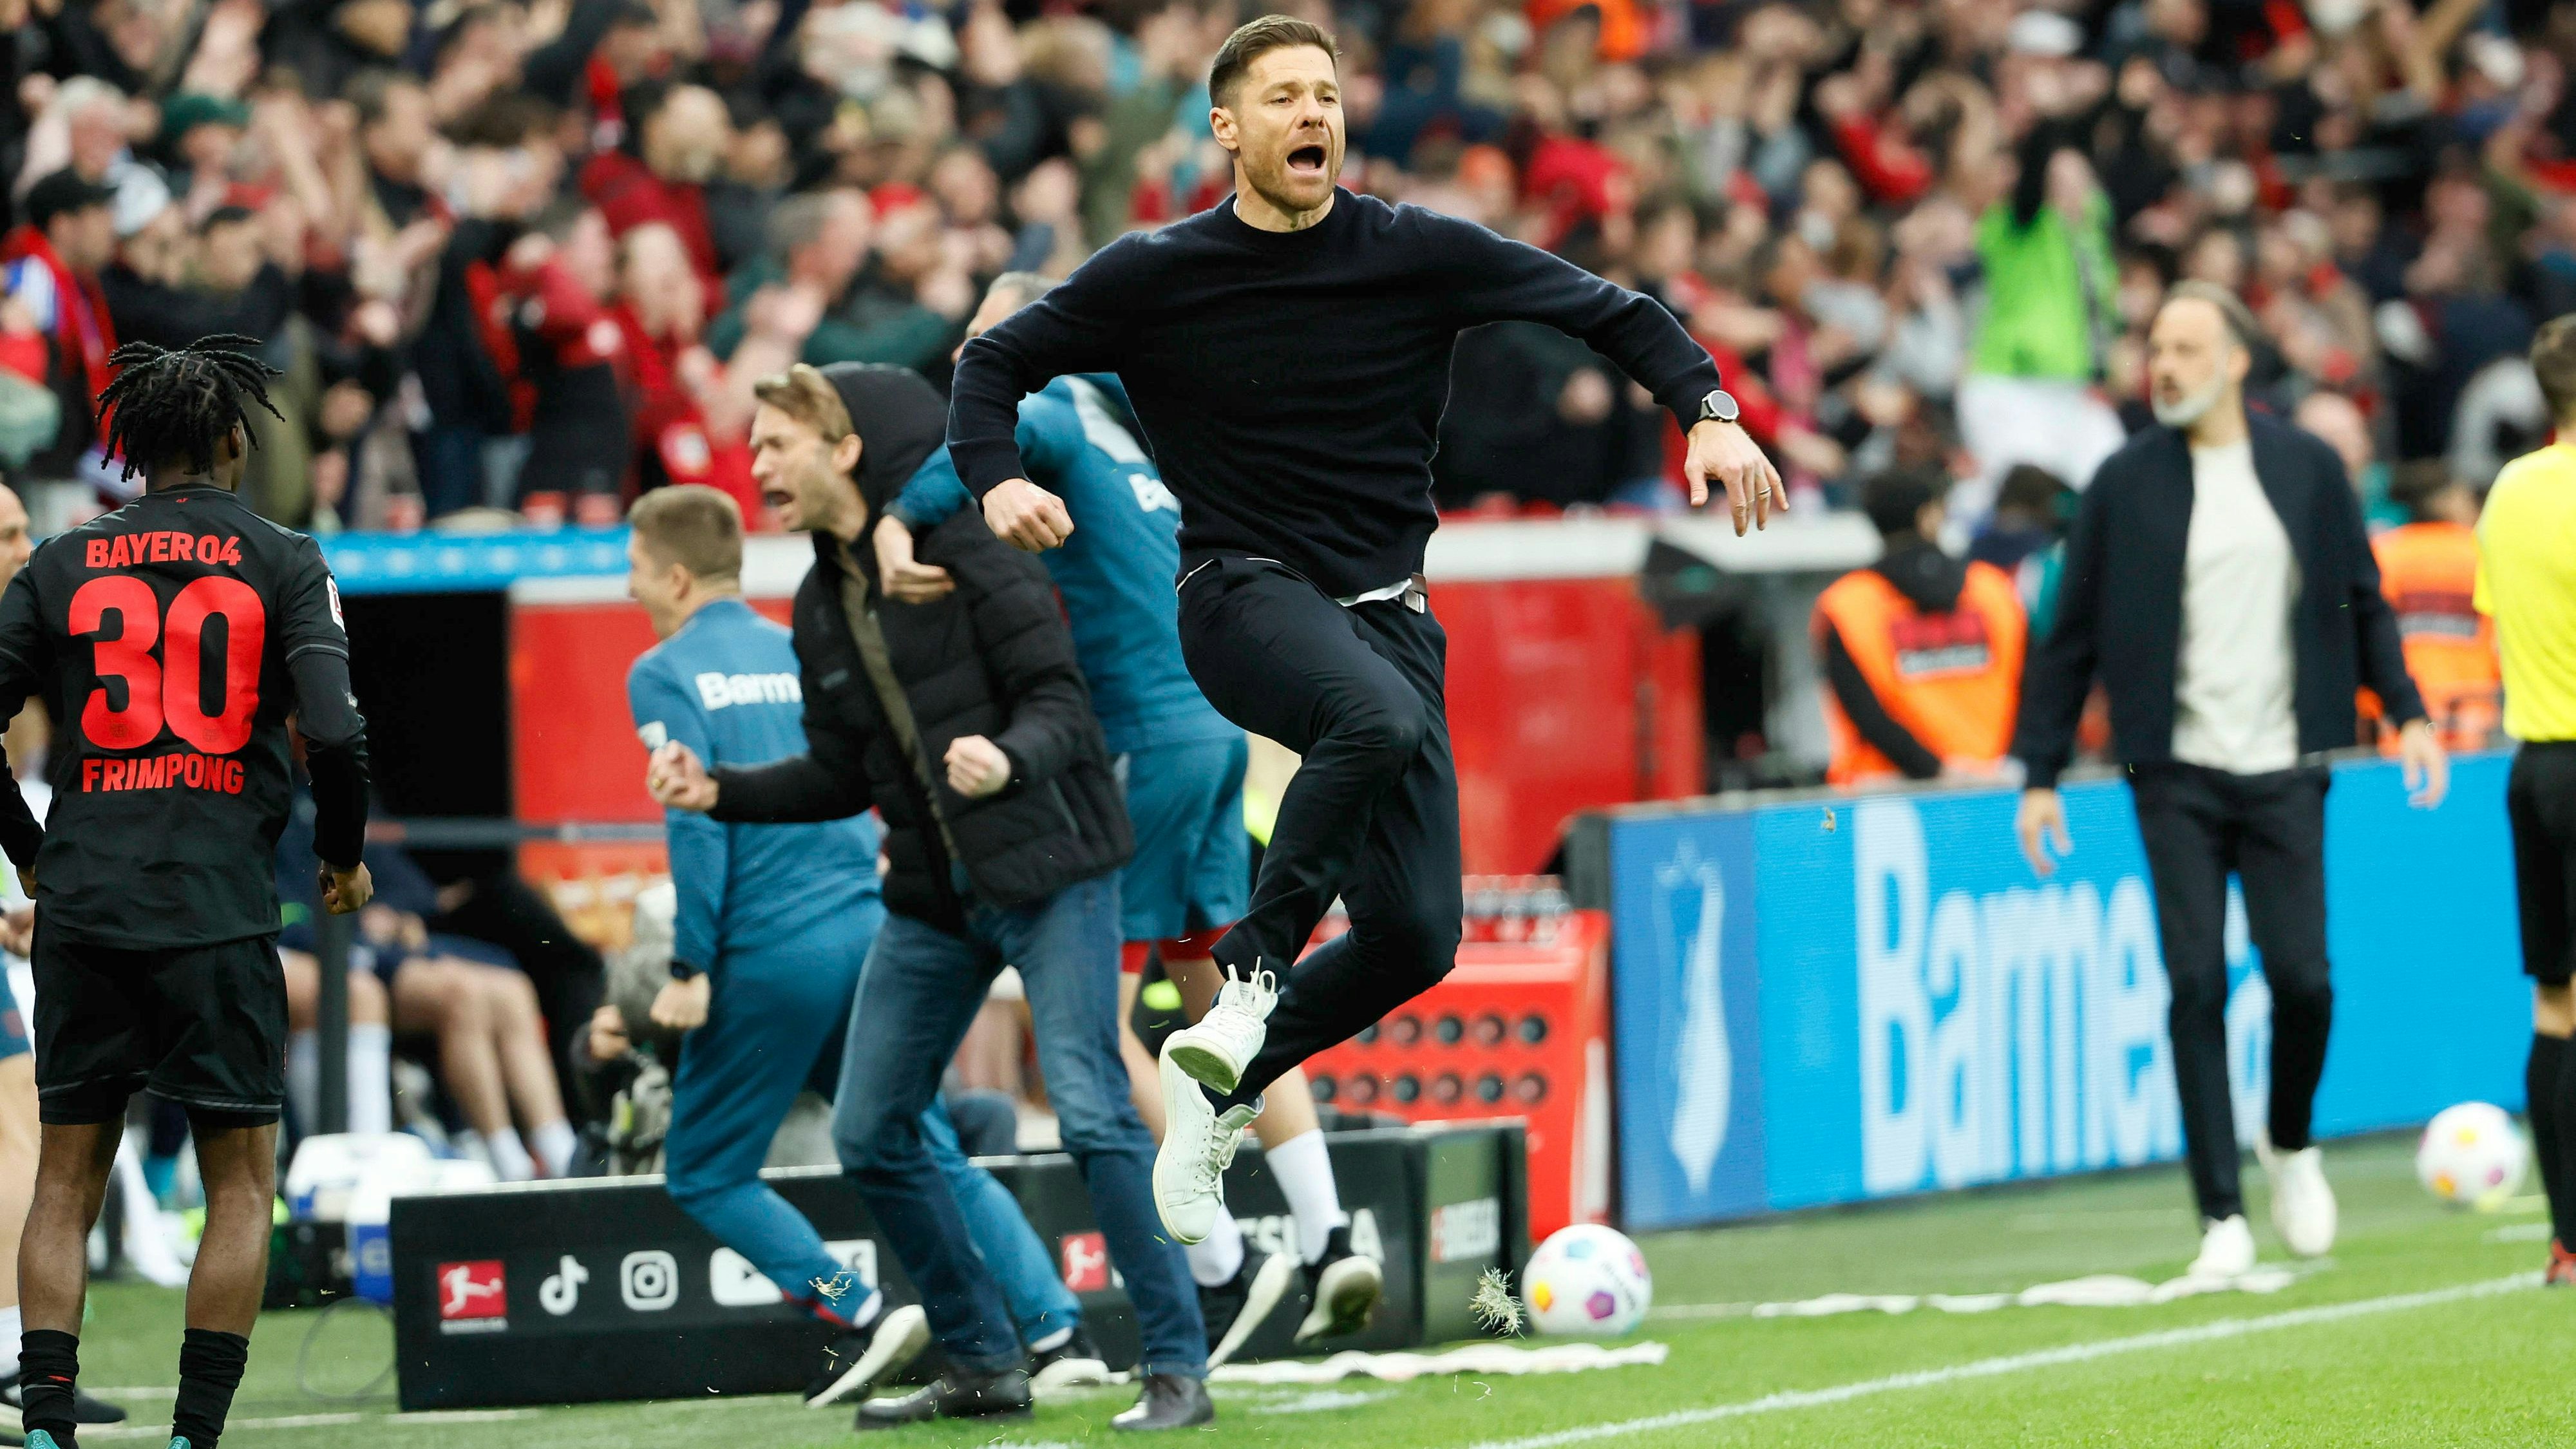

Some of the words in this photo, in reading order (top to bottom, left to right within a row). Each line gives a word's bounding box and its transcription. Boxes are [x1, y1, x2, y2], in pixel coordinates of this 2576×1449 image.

[68, 575, 265, 754] 30
[695, 671, 802, 710] Barm
[82, 753, 243, 794] FRIMPONG
